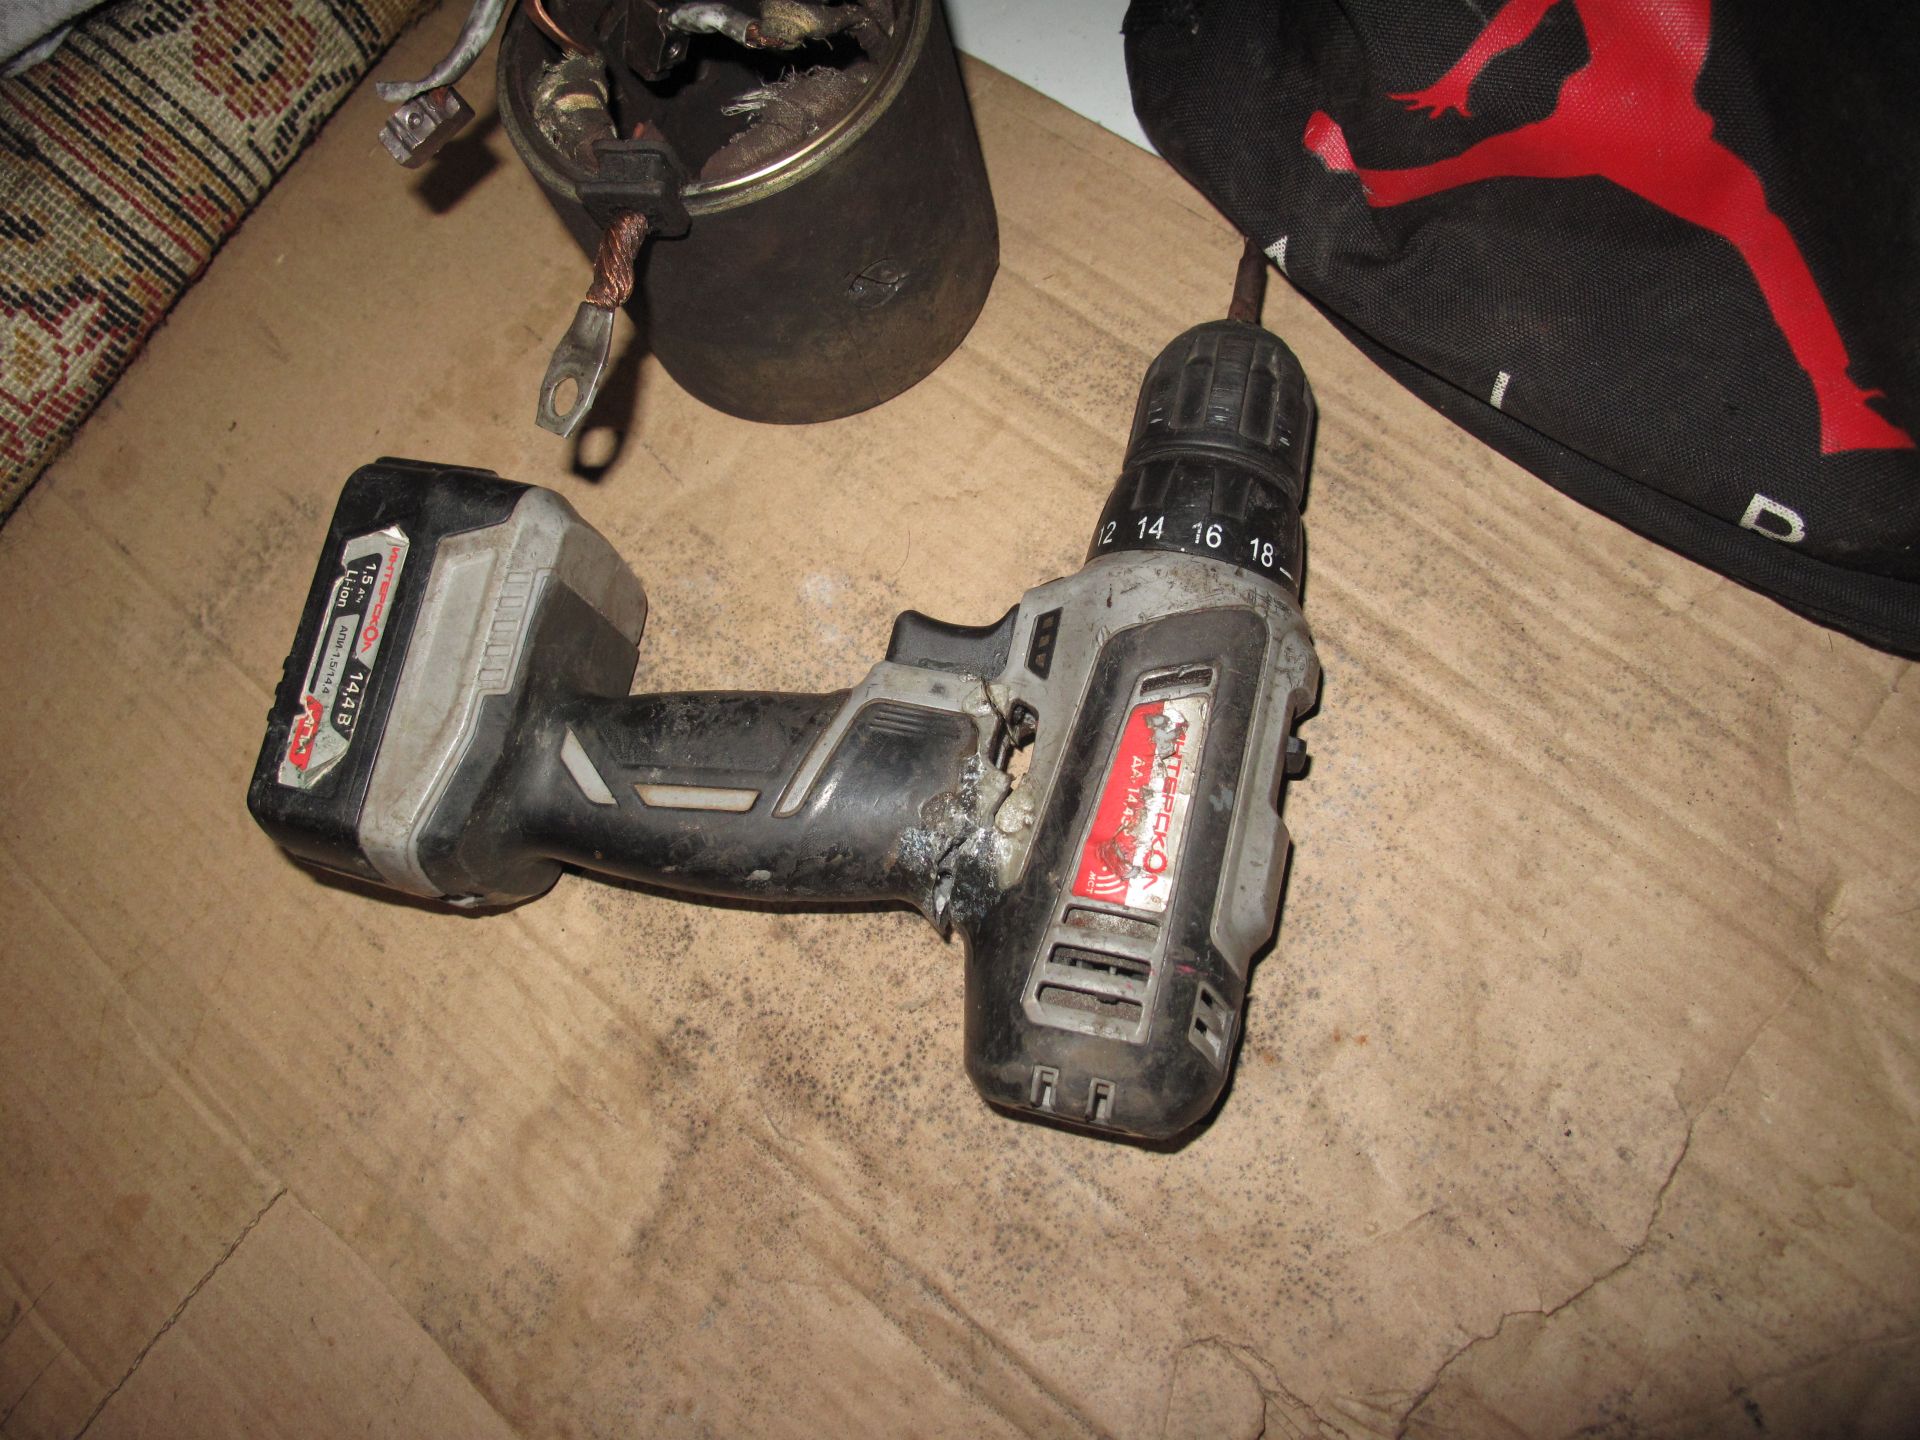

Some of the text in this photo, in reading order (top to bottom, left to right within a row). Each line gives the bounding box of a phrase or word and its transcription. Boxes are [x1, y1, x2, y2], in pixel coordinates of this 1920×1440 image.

[1098, 515, 1274, 568] 12 14 16 18
[337, 569, 359, 608] Li-ion
[361, 562, 377, 586] 1,5
[361, 546, 400, 653] ИНТЕРСКОЛ
[321, 624, 349, 695] АПИ-1,5/14,4
[339, 672, 364, 710] 14,4
